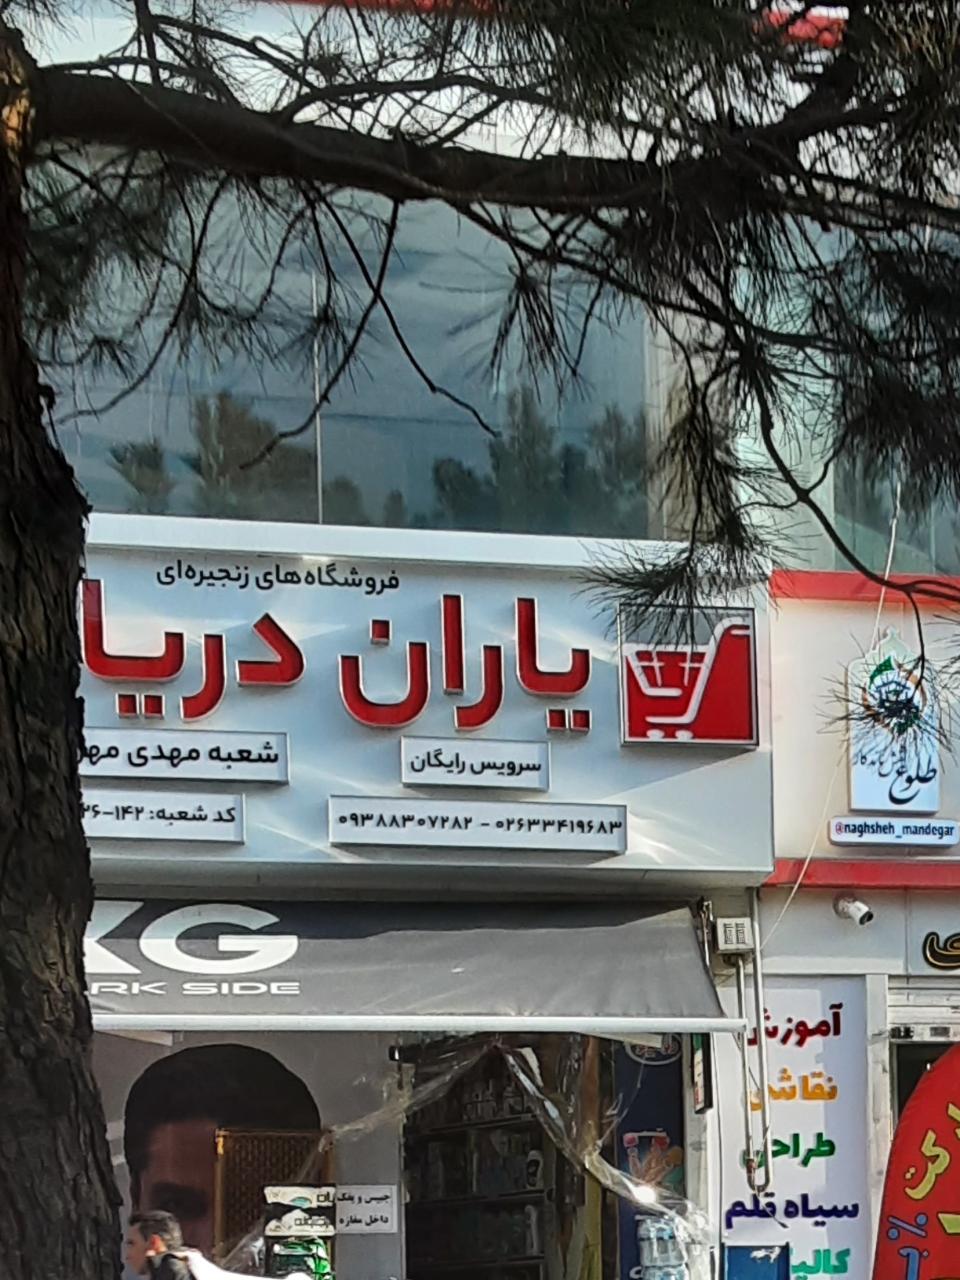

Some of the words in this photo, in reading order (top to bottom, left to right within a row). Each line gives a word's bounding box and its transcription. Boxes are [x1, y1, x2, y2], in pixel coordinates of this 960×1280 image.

[80, 578, 306, 722] دریا
[339, 594, 592, 731] یاران
[127, 744, 201, 769] مهدی
[207, 741, 279, 770] شعبه
[410, 748, 466, 775] رایگان
[470, 760, 542, 777] سرویس
[212, 806, 237, 823] کد
[182, 982, 300, 995] SIDE
[364, 1213, 390, 1226] داخل
[725, 1191, 778, 1230] قلم
[784, 1193, 860, 1227] سیاه
